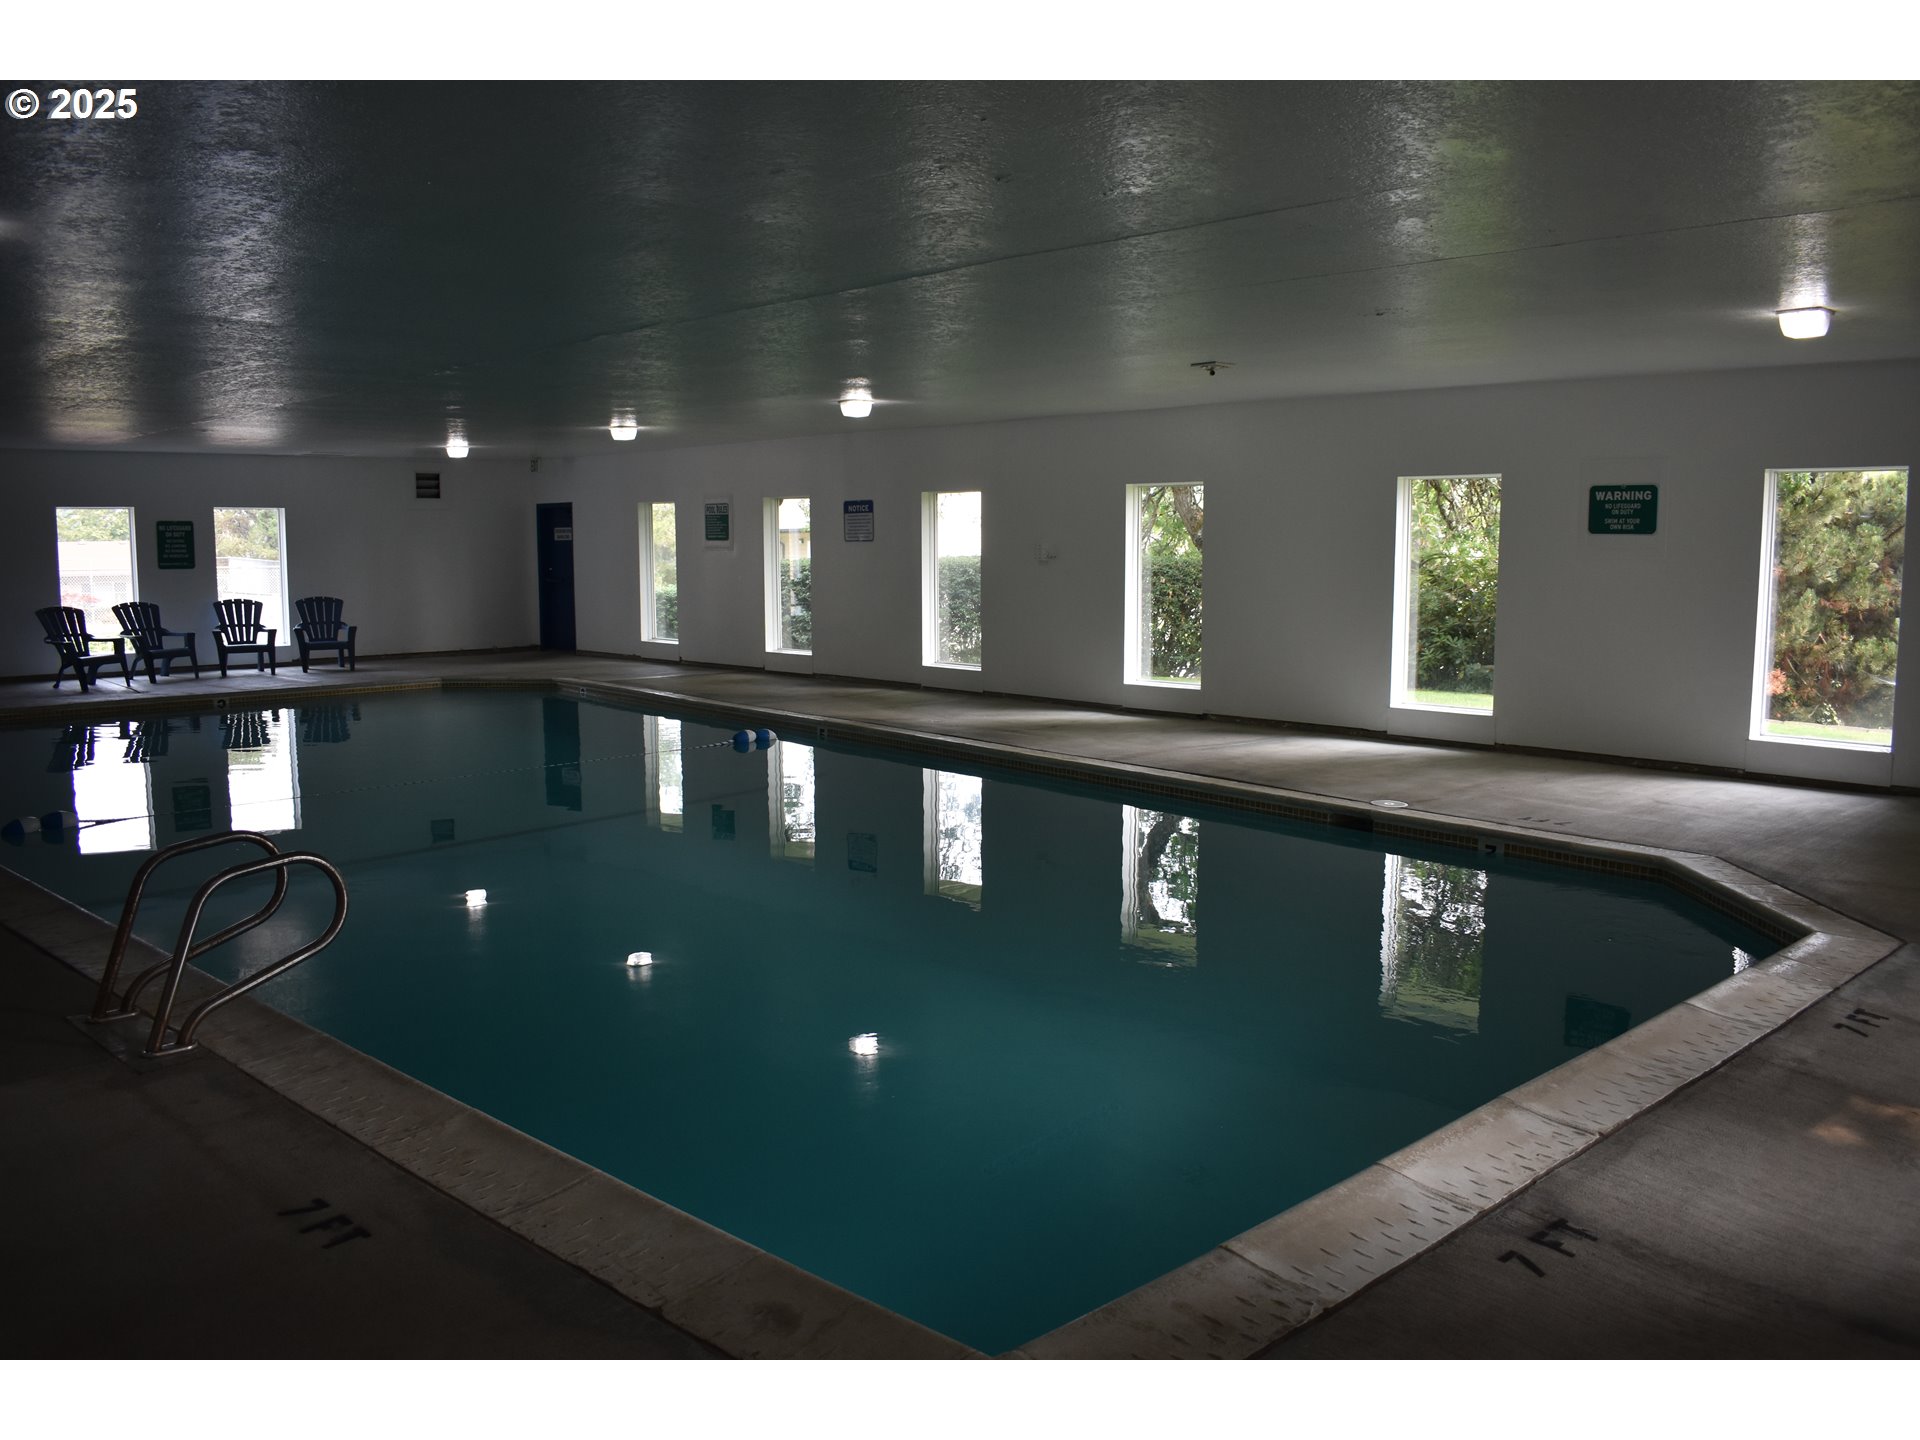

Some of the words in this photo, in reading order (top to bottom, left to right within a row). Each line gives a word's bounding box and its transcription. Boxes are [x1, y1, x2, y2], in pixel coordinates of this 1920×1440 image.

[1595, 490, 1653, 501] WARNING
[848, 504, 870, 513] NOTICE
[1845, 1007, 1889, 1028] FT
[1832, 1023, 1869, 1038] 7
[277, 1198, 330, 1216] 7
[299, 1214, 371, 1249] FT
[1498, 1249, 1545, 1277] 7
[1528, 1219, 1598, 1257] FT
